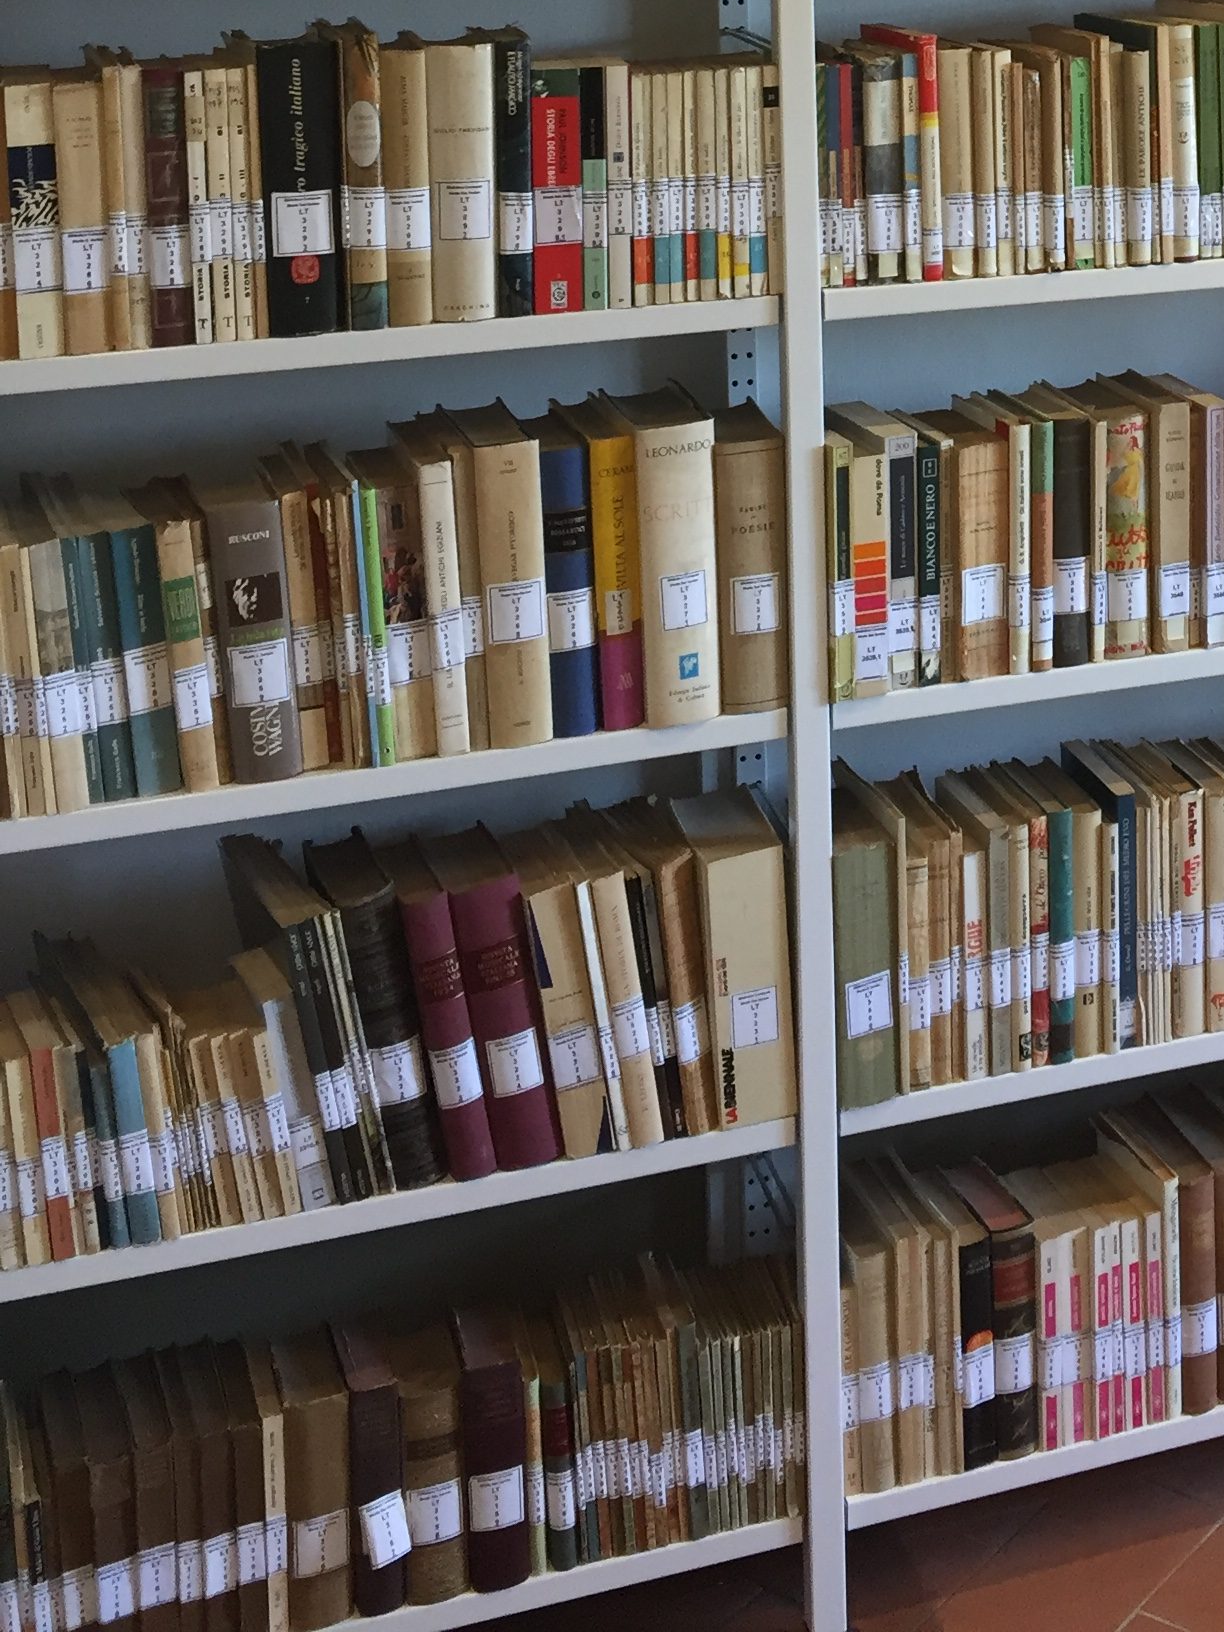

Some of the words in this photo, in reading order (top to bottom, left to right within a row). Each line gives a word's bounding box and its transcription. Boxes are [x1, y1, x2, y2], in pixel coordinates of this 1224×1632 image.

[289, 58, 303, 116] italiano
[546, 108, 556, 139] STORIA
[291, 121, 309, 172] tragico
[546, 141, 556, 163] DEGLI
[196, 268, 204, 301] STORIA
[243, 265, 251, 298] STORIA
[645, 439, 712, 458] LEONARDO
[875, 459, 884, 480] dove
[612, 495, 625, 529] SOLE
[644, 501, 710, 521] SCRITT
[875, 493, 884, 516] Roma
[925, 483, 936, 519] NERO
[228, 529, 270, 544] RUSCONI
[925, 530, 936, 580] BIANCO
[721, 1048, 736, 1109] BIENNALE
